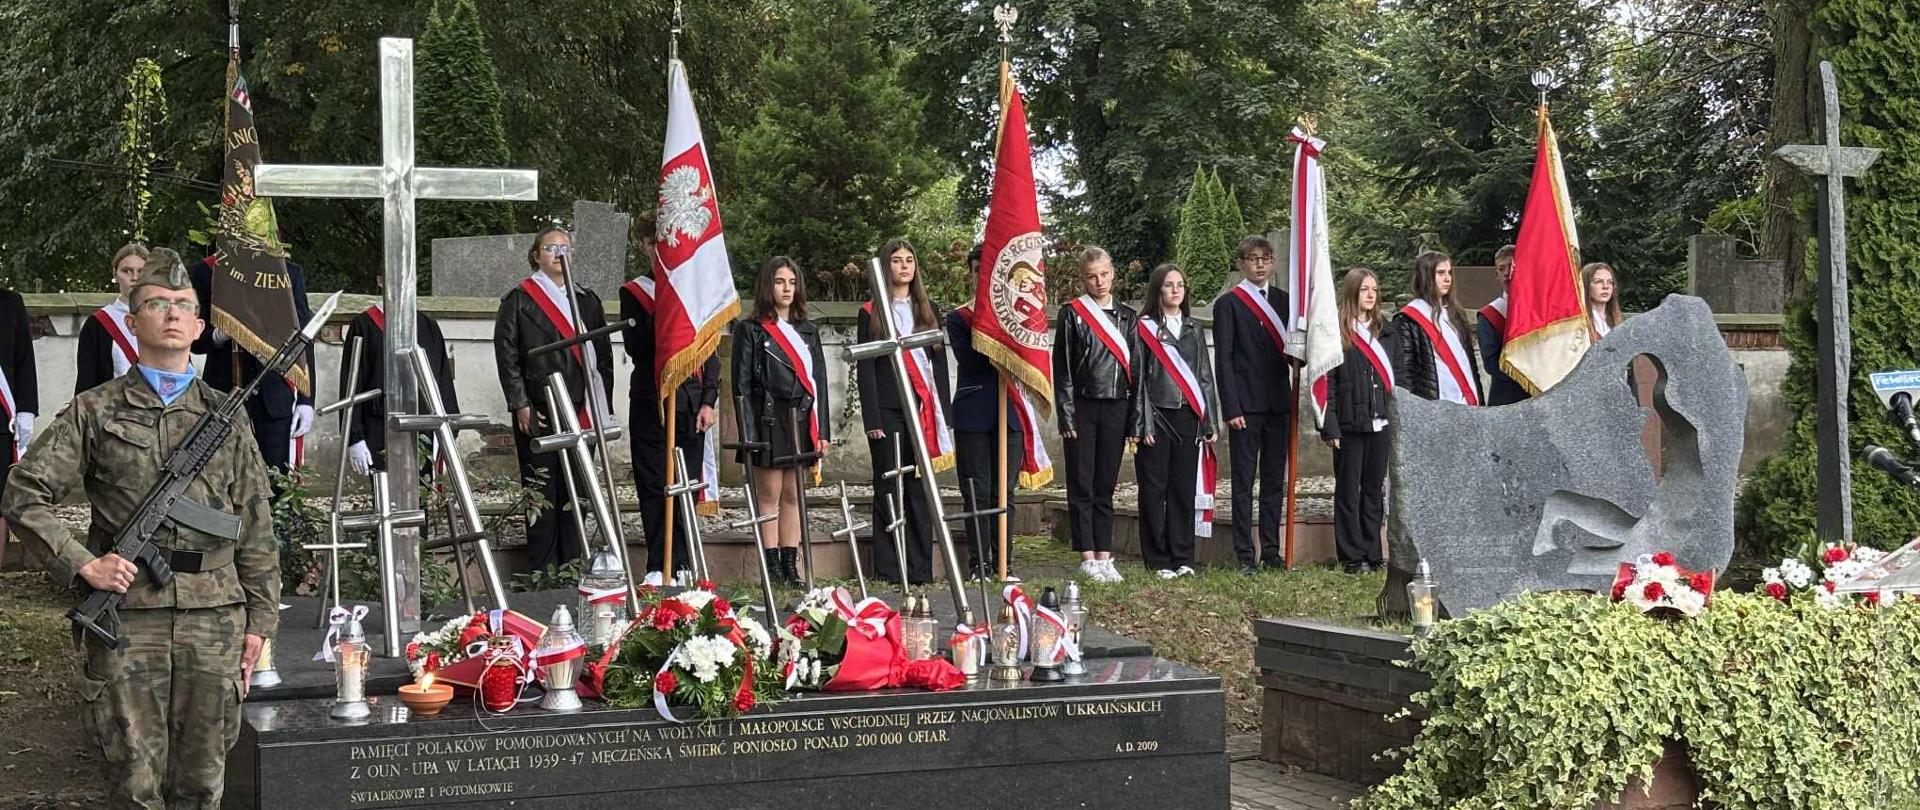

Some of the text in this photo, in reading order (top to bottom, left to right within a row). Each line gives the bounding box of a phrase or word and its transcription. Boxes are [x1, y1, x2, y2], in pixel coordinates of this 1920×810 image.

[351, 742, 409, 760] PAMIĘCI
[417, 737, 487, 755] POLAKÓW
[495, 730, 625, 751] POMORDOWANYCH
[632, 728, 651, 742] NA
[729, 721, 733, 736] I
[740, 718, 825, 736] MAŁOPOLSCE
[830, 713, 911, 729] WSCHODNIEJ
[917, 710, 956, 724] PRZEZ
[961, 704, 1060, 723] NACJONALISTÓW
[1066, 699, 1163, 716] UKRAIŃSKICH
[1137, 741, 1158, 751] 2009
[350, 766, 360, 779] Z
[447, 760, 460, 772] W
[468, 757, 520, 771] LATACH
[591, 745, 673, 765] MĘCZEŃSKĄ
[680, 740, 728, 757] ŚMIERĆ
[733, 738, 798, 754] PONIOSŁO
[804, 735, 849, 750] PONAD
[908, 730, 950, 743] OFIAR.
[350, 782, 514, 803] ŚWIADKOWIE I POTOMKOWIE
